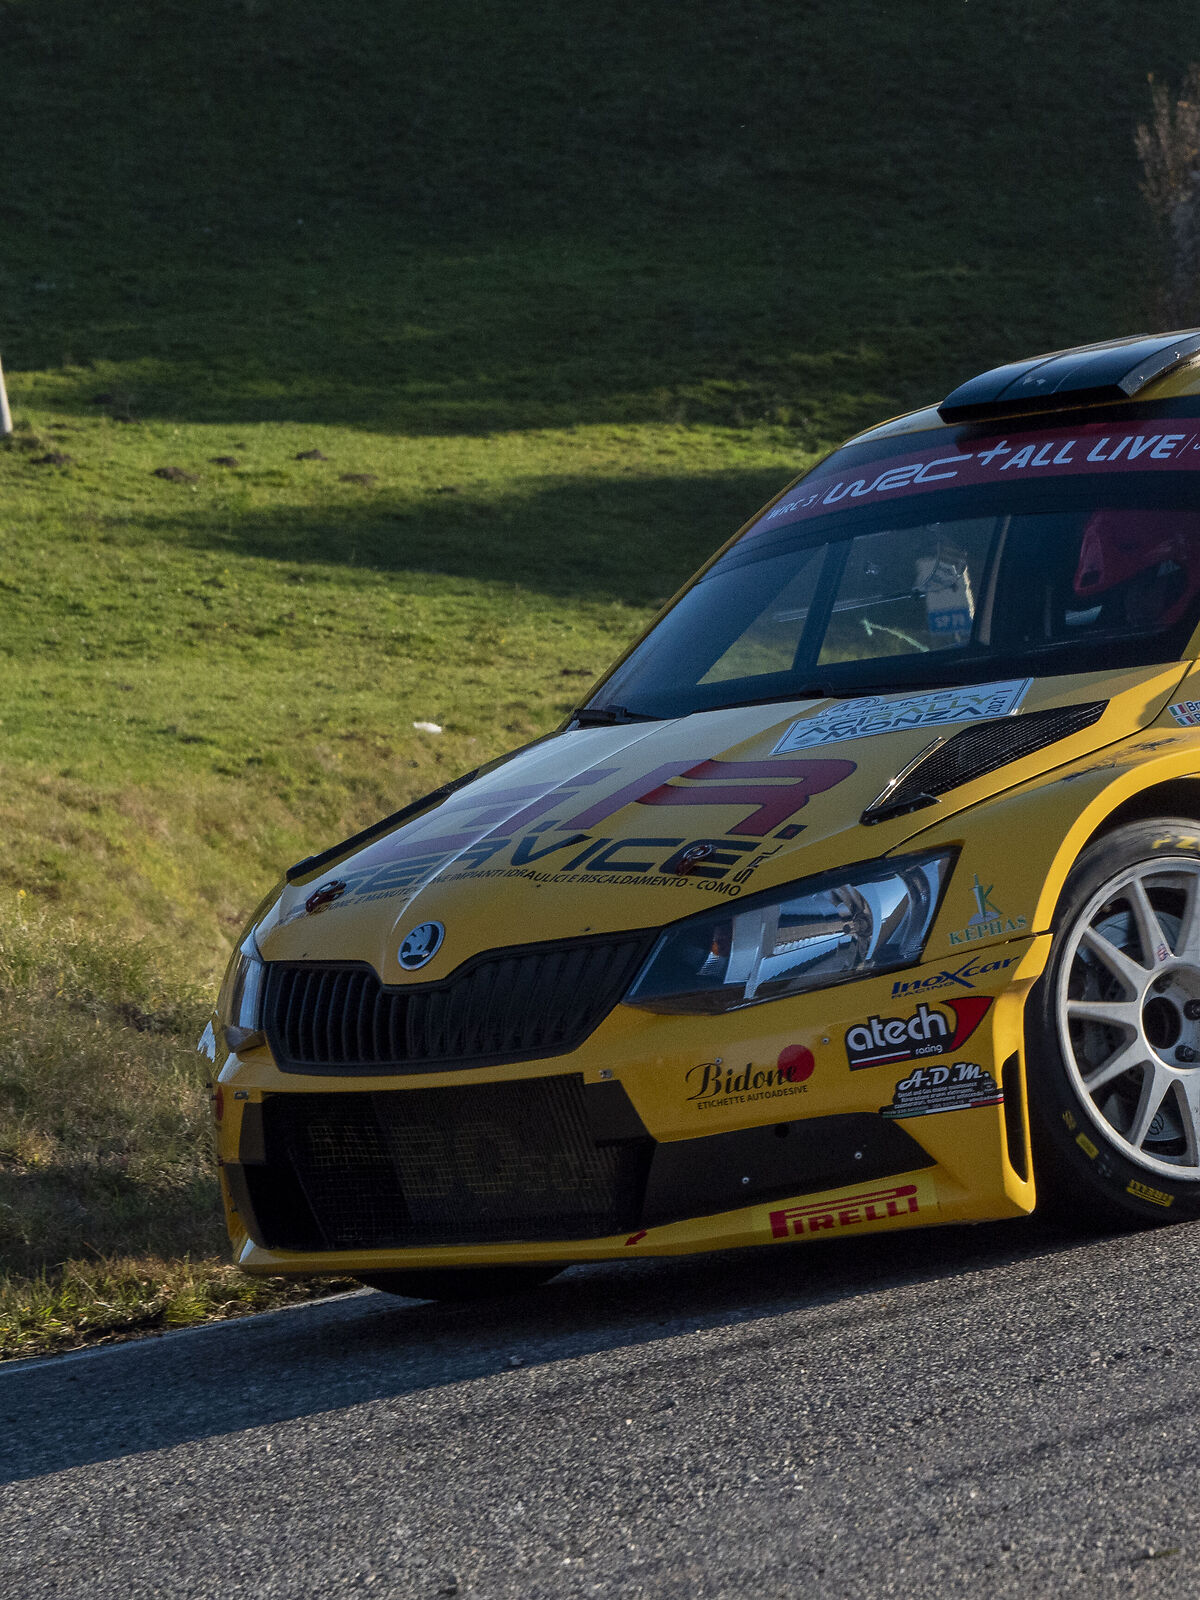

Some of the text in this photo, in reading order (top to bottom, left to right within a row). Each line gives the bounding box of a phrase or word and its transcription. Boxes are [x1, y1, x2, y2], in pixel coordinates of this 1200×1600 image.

[1000, 440, 1078, 470] ALL
[1086, 433, 1186, 462] LIVE
[820, 706, 983, 742] MONZA
[506, 868, 566, 883] IDRAULICI
[577, 873, 689, 888] RISCALDAMENTO
[696, 879, 742, 897] COMO
[949, 915, 1028, 946] KEPHAS
[847, 1006, 948, 1052] atech
[915, 1043, 944, 1055] racing
[685, 1061, 798, 1101] Bidone
[898, 1063, 990, 1091] A.D.M.
[698, 1084, 809, 1110] ETICHETTE AUTOADESIVE
[768, 1184, 920, 1239] PIRELLI
